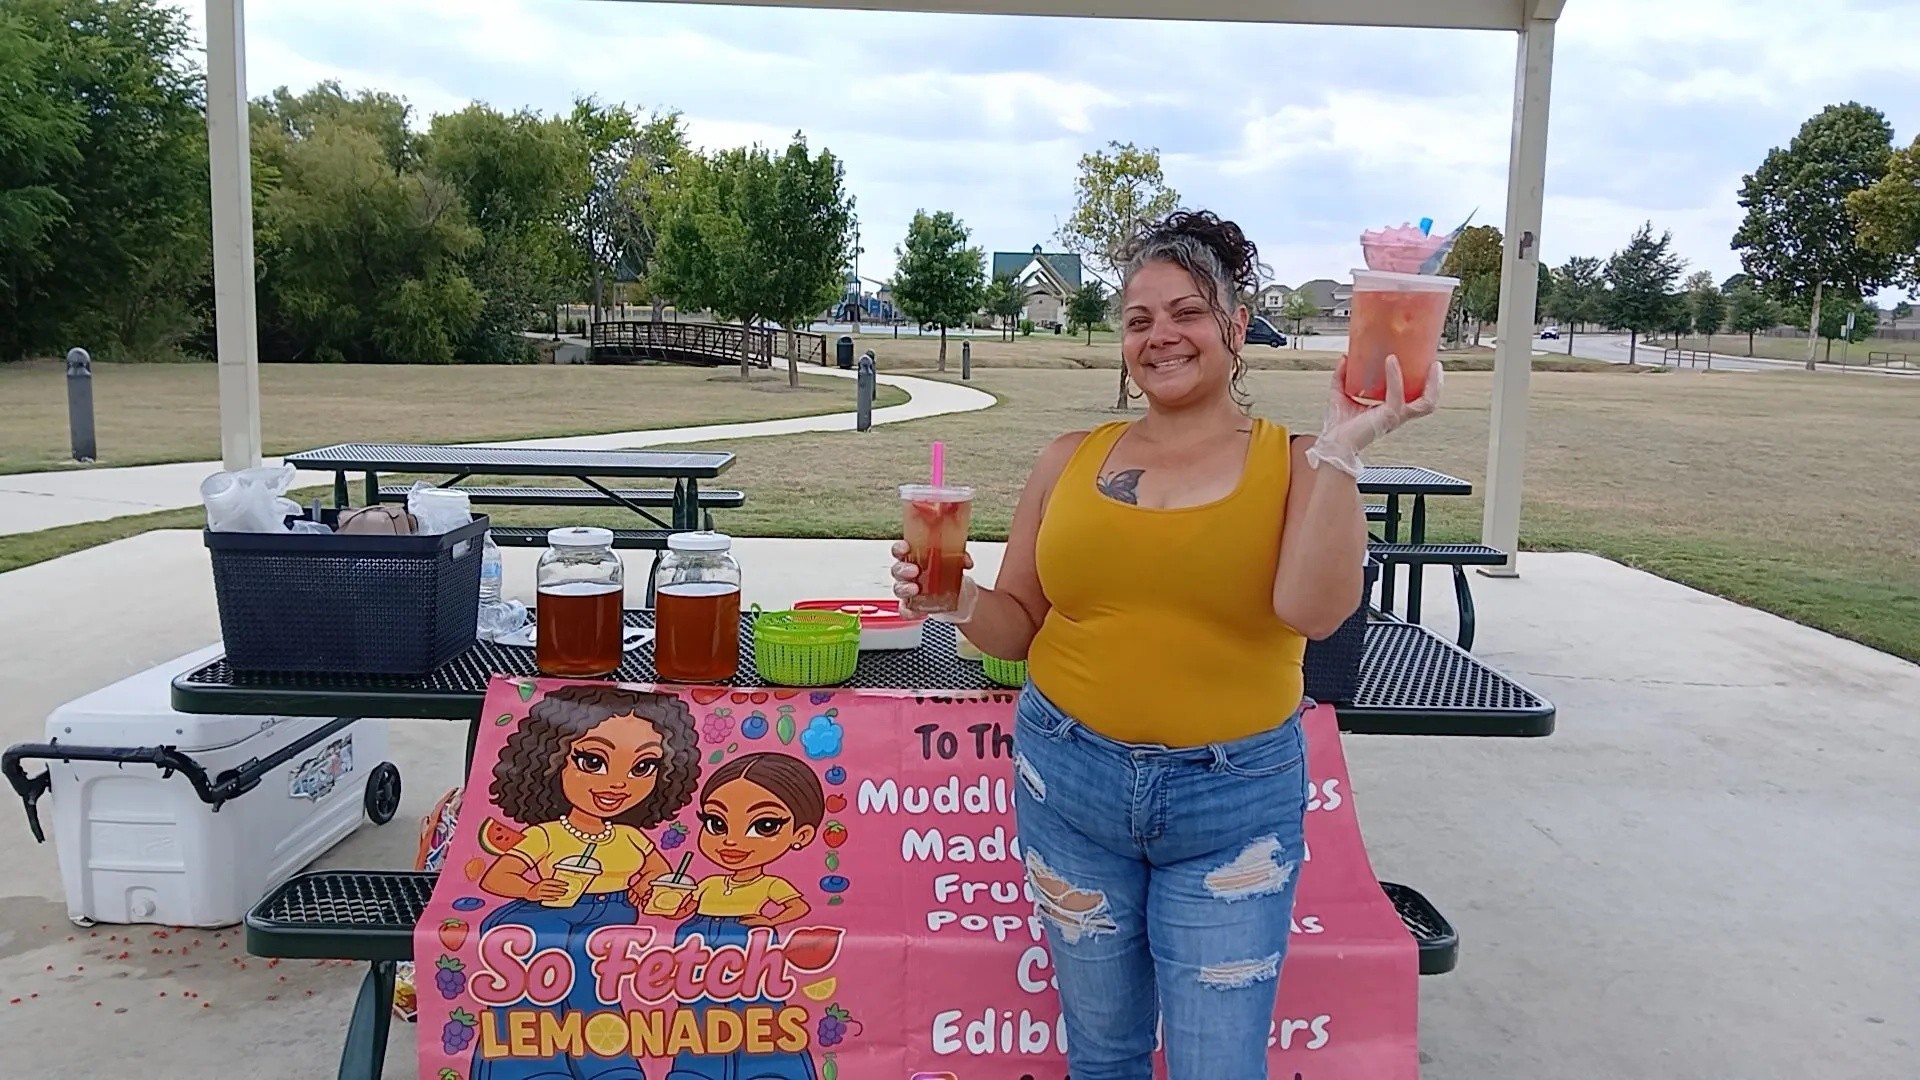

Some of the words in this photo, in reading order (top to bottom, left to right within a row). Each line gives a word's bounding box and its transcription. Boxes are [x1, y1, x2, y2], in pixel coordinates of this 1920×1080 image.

[914, 723, 958, 760] To
[967, 722, 1014, 760] Th
[857, 775, 1016, 815] Muddl
[933, 872, 1034, 904] Frui
[926, 909, 1046, 942] Popp
[467, 925, 575, 1006] So
[588, 925, 797, 1004] Fetch
[479, 1006, 809, 1059] LEMONADES
[932, 1007, 1069, 1055] Edibl
